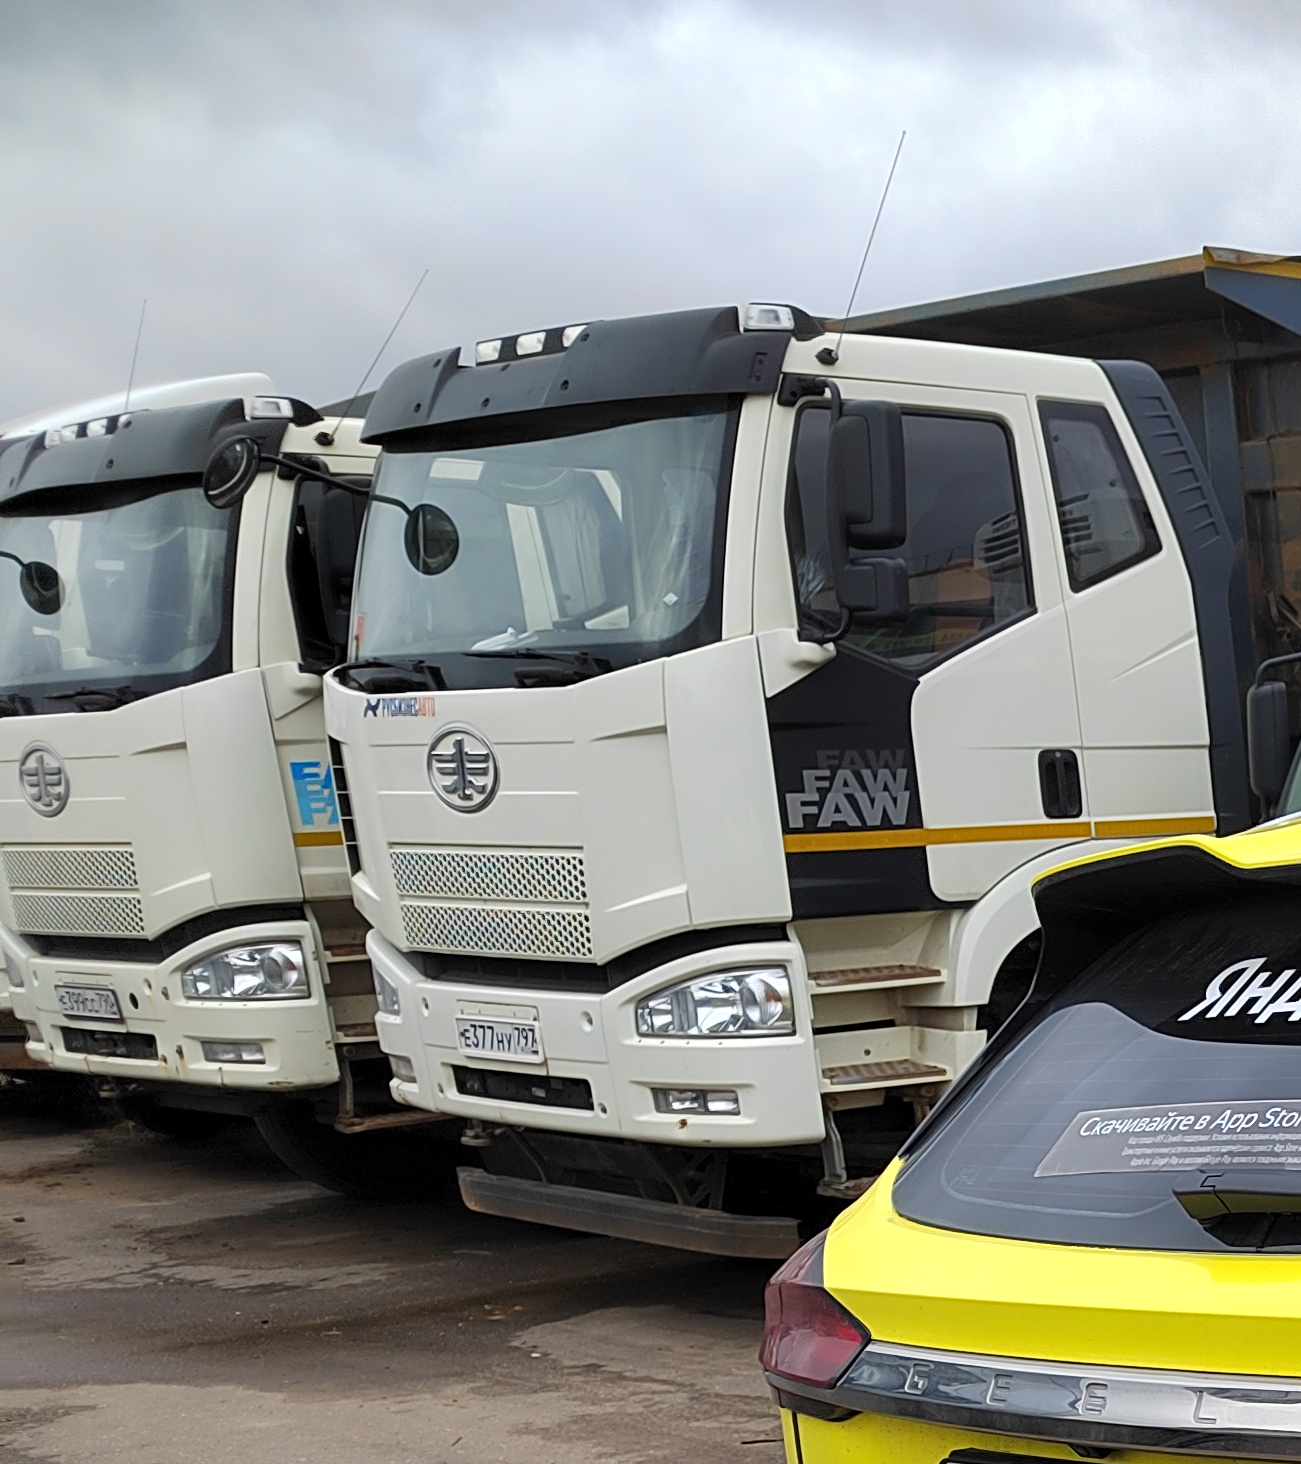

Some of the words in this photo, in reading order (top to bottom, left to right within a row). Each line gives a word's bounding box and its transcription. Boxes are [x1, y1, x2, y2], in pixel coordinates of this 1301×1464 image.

[816, 749, 905, 771] FAW
[802, 768, 908, 798] FAW
[785, 791, 910, 828] FAW
[1079, 1111, 1195, 1136] Скачивайте
[1195, 1115, 1212, 1131] в
[1208, 1109, 1258, 1133] App
